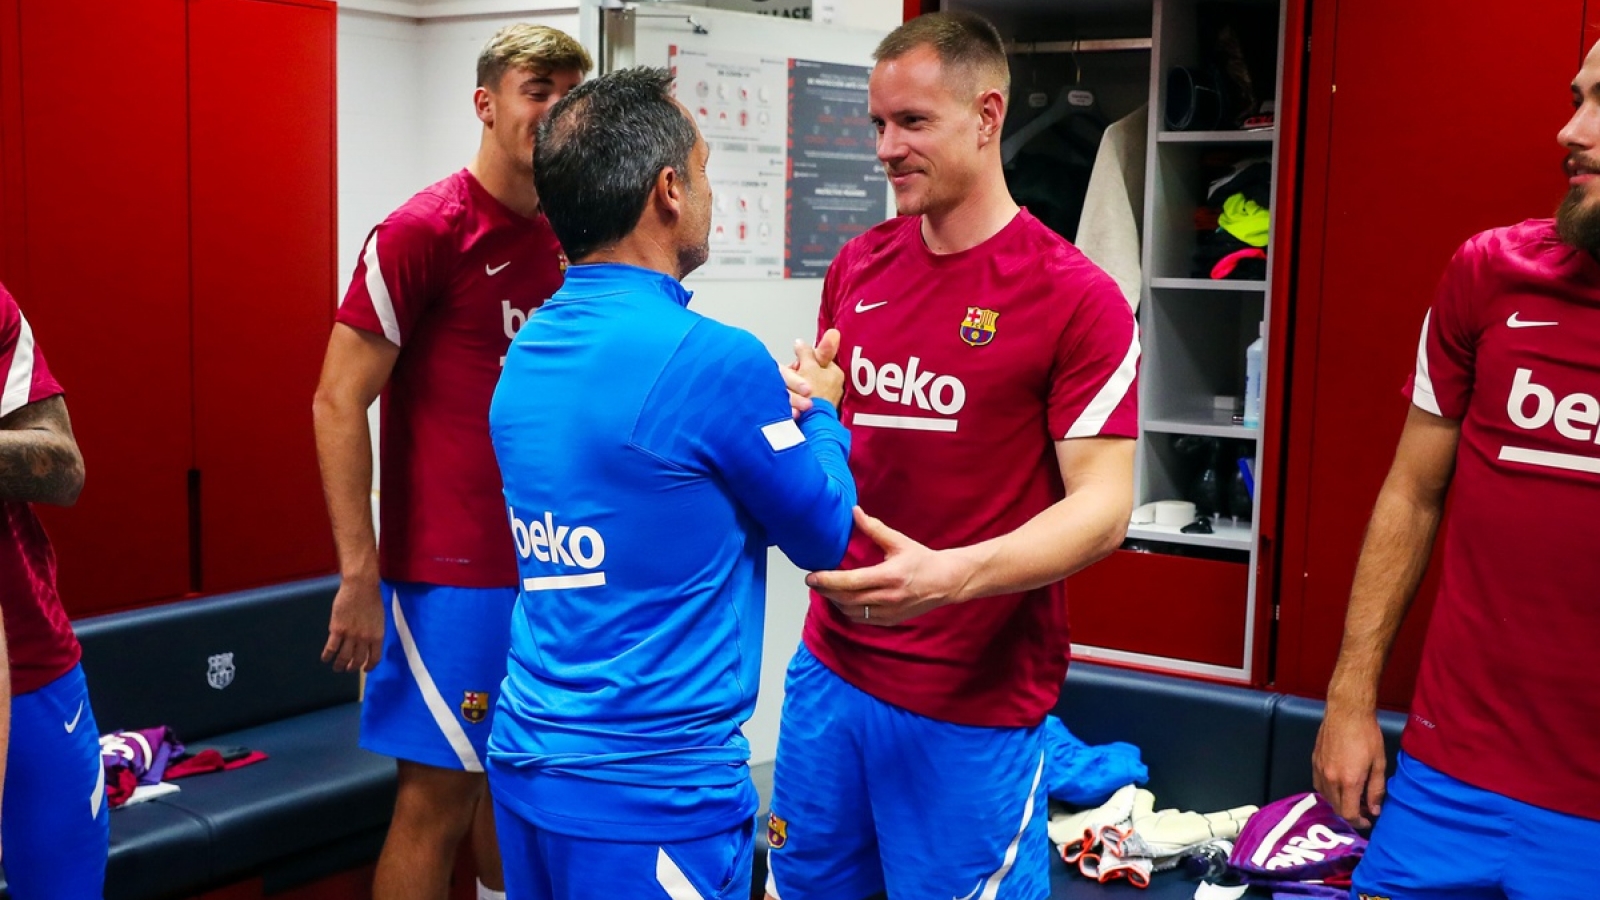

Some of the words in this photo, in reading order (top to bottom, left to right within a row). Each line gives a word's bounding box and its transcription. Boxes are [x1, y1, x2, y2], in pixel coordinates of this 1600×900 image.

[851, 345, 966, 415] beko
[1507, 367, 1600, 445] be
[509, 506, 605, 569] beko
